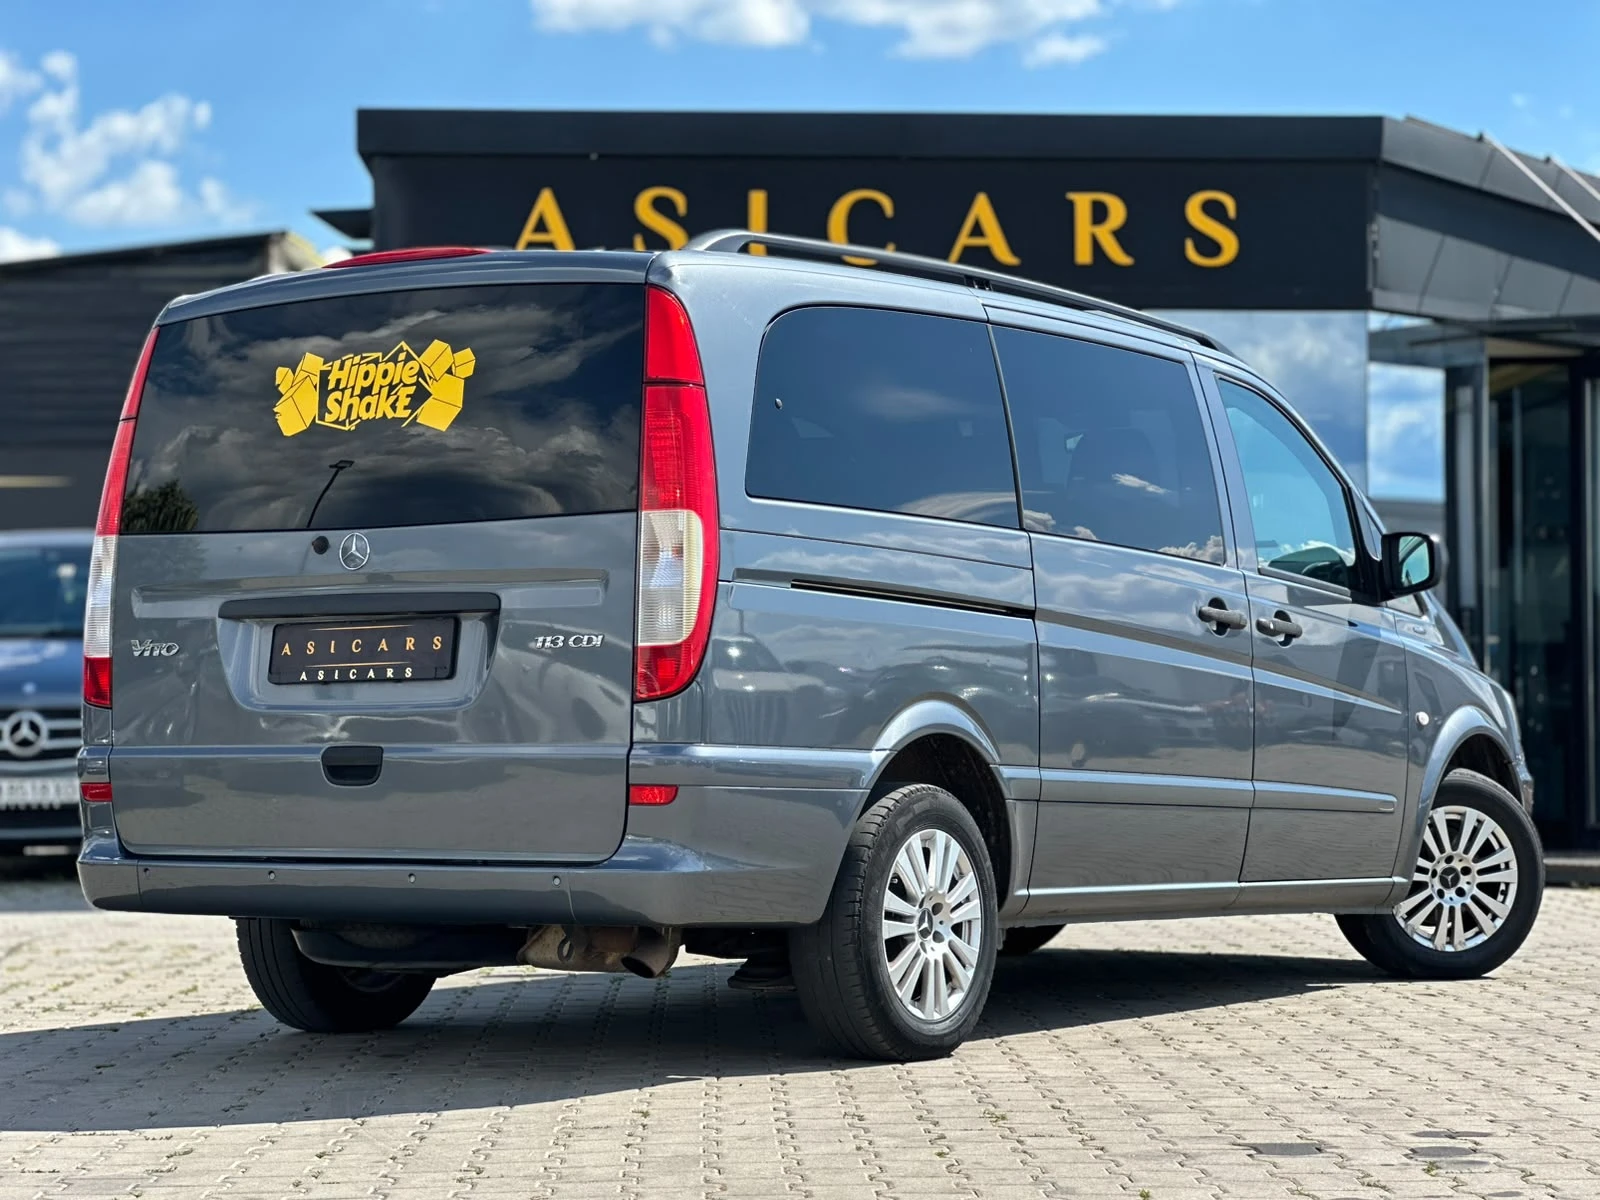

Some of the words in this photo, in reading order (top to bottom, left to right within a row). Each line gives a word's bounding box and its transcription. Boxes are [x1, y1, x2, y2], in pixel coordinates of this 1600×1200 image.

[515, 187, 1240, 268] ASICARS
[327, 350, 420, 395] Hippie
[281, 635, 443, 657] ASICARS
[534, 635, 565, 649] 113
[568, 634, 604, 648] CDI
[299, 667, 413, 682] ASICARS
